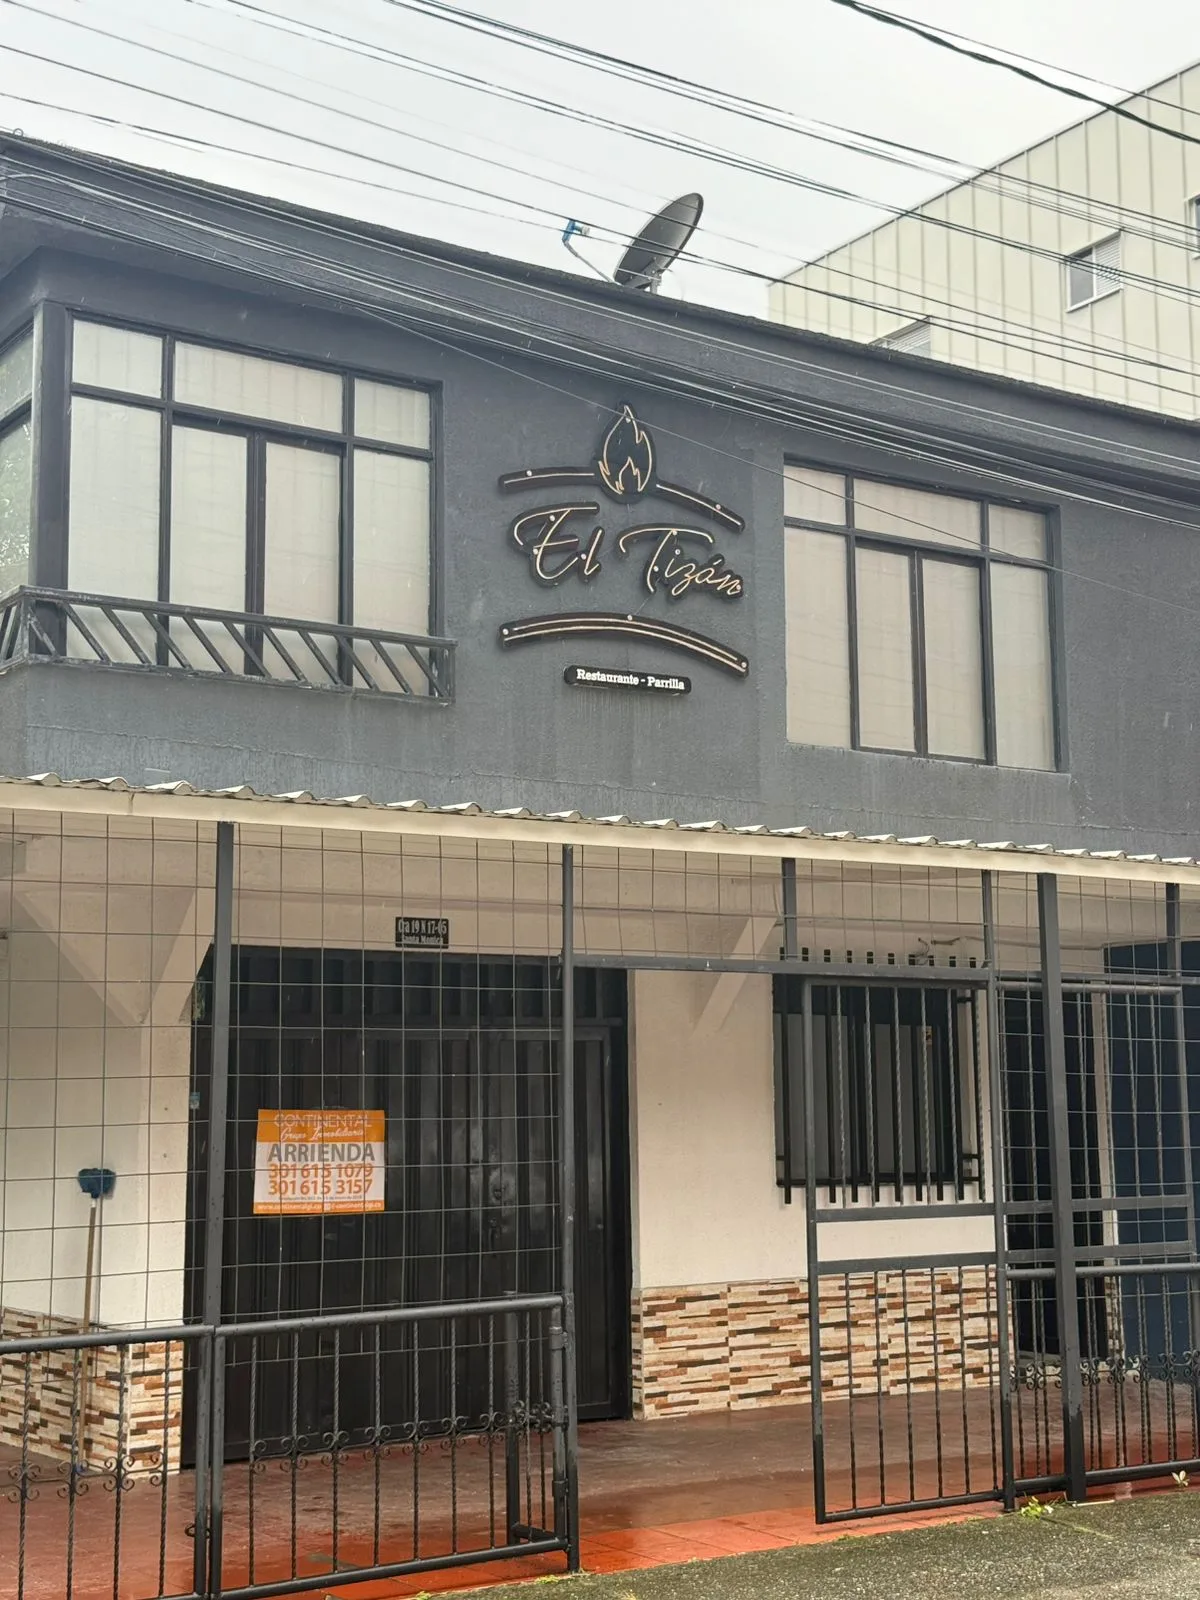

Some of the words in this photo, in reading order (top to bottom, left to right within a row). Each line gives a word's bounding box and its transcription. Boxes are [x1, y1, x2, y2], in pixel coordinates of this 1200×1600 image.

[511, 504, 603, 585] El
[617, 524, 744, 599] Tizán
[576, 668, 640, 685] Restaurante
[647, 675, 686, 691] Parrilla
[411, 919, 420, 934] 19
[273, 1112, 373, 1128] CONTINENTAL
[281, 1127, 307, 1141] Grupo
[267, 1143, 376, 1162] ARRIENDA
[268, 1163, 297, 1179] 301
[300, 1163, 332, 1179] 615
[336, 1163, 373, 1178] 1079
[268, 1180, 297, 1195] 301
[300, 1180, 332, 1195] 615
[335, 1179, 373, 1194] 3157
